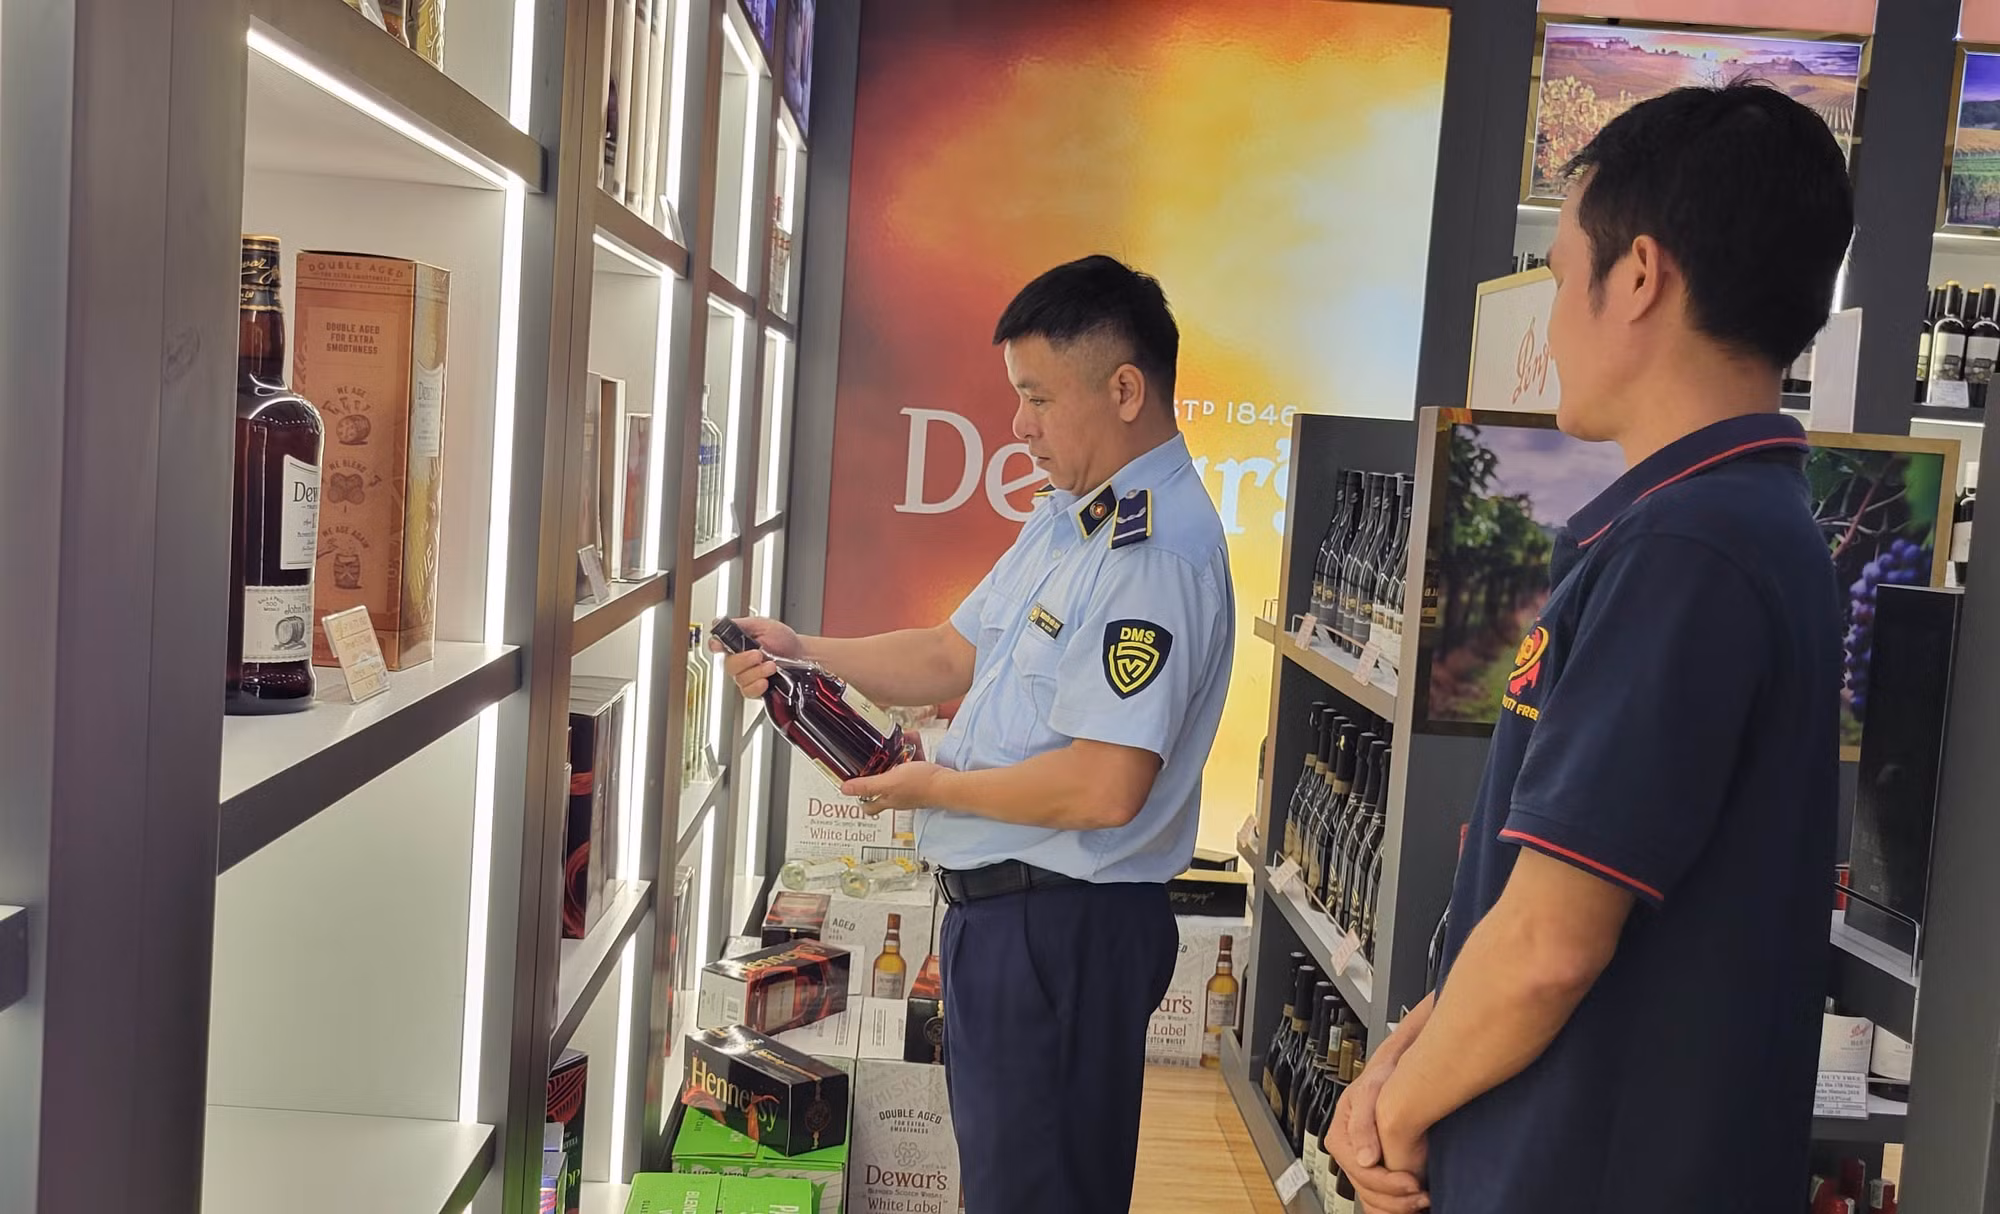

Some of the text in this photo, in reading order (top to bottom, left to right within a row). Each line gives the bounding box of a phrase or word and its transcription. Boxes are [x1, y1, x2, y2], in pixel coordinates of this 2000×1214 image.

[308, 262, 404, 278] DOUBLE AGED
[326, 322, 380, 334] DOUBLE AGED
[331, 333, 375, 344] FOR EXTRA
[326, 343, 379, 355] SMOOTHNESS
[337, 385, 367, 398] WE AGE
[1227, 401, 1297, 426] 1846
[329, 459, 368, 474] WE BLEND
[1120, 627, 1156, 644] DMS
[808, 797, 880, 821] Dewa
[810, 827, 876, 843] White Label
[832, 918, 856, 932] AGED
[1159, 994, 1193, 1015] ar's
[1153, 1023, 1187, 1037] Label
[690, 1055, 780, 1132] Hennesy
[879, 1108, 943, 1125] DOUBLE AGED
[890, 1126, 929, 1135] SMOOTHNESS
[864, 1164, 948, 1191] Dewar's
[868, 1196, 942, 1214] White Label
